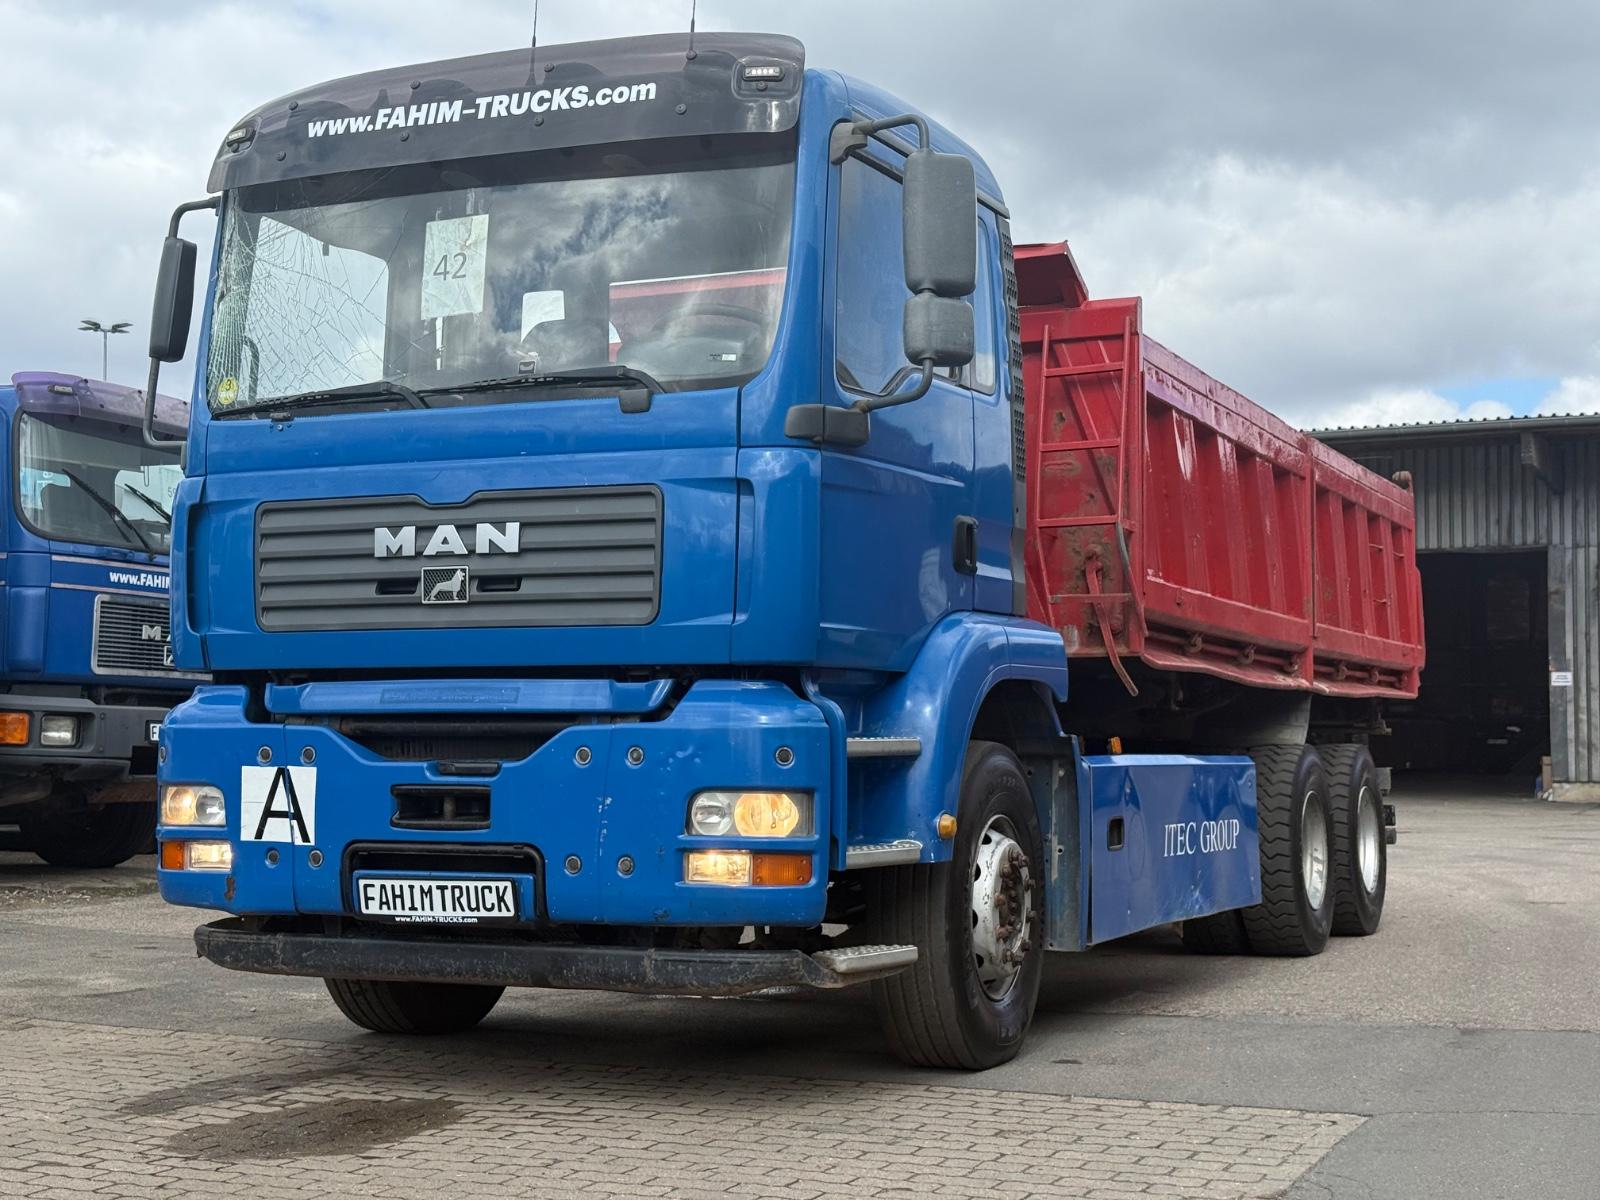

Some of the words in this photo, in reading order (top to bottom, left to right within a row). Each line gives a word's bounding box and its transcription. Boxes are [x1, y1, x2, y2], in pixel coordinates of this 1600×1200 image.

[308, 82, 657, 138] www.FAHIM-TRUCKS.com
[433, 252, 467, 281] 42
[374, 522, 520, 557] MAN
[254, 767, 311, 843] A
[1163, 821, 1197, 857] ITEC
[1200, 819, 1240, 853] GROUP
[363, 883, 511, 913] FAHIMTRUCK
[395, 915, 478, 924] www.FAHIM-TRUCKS.com
